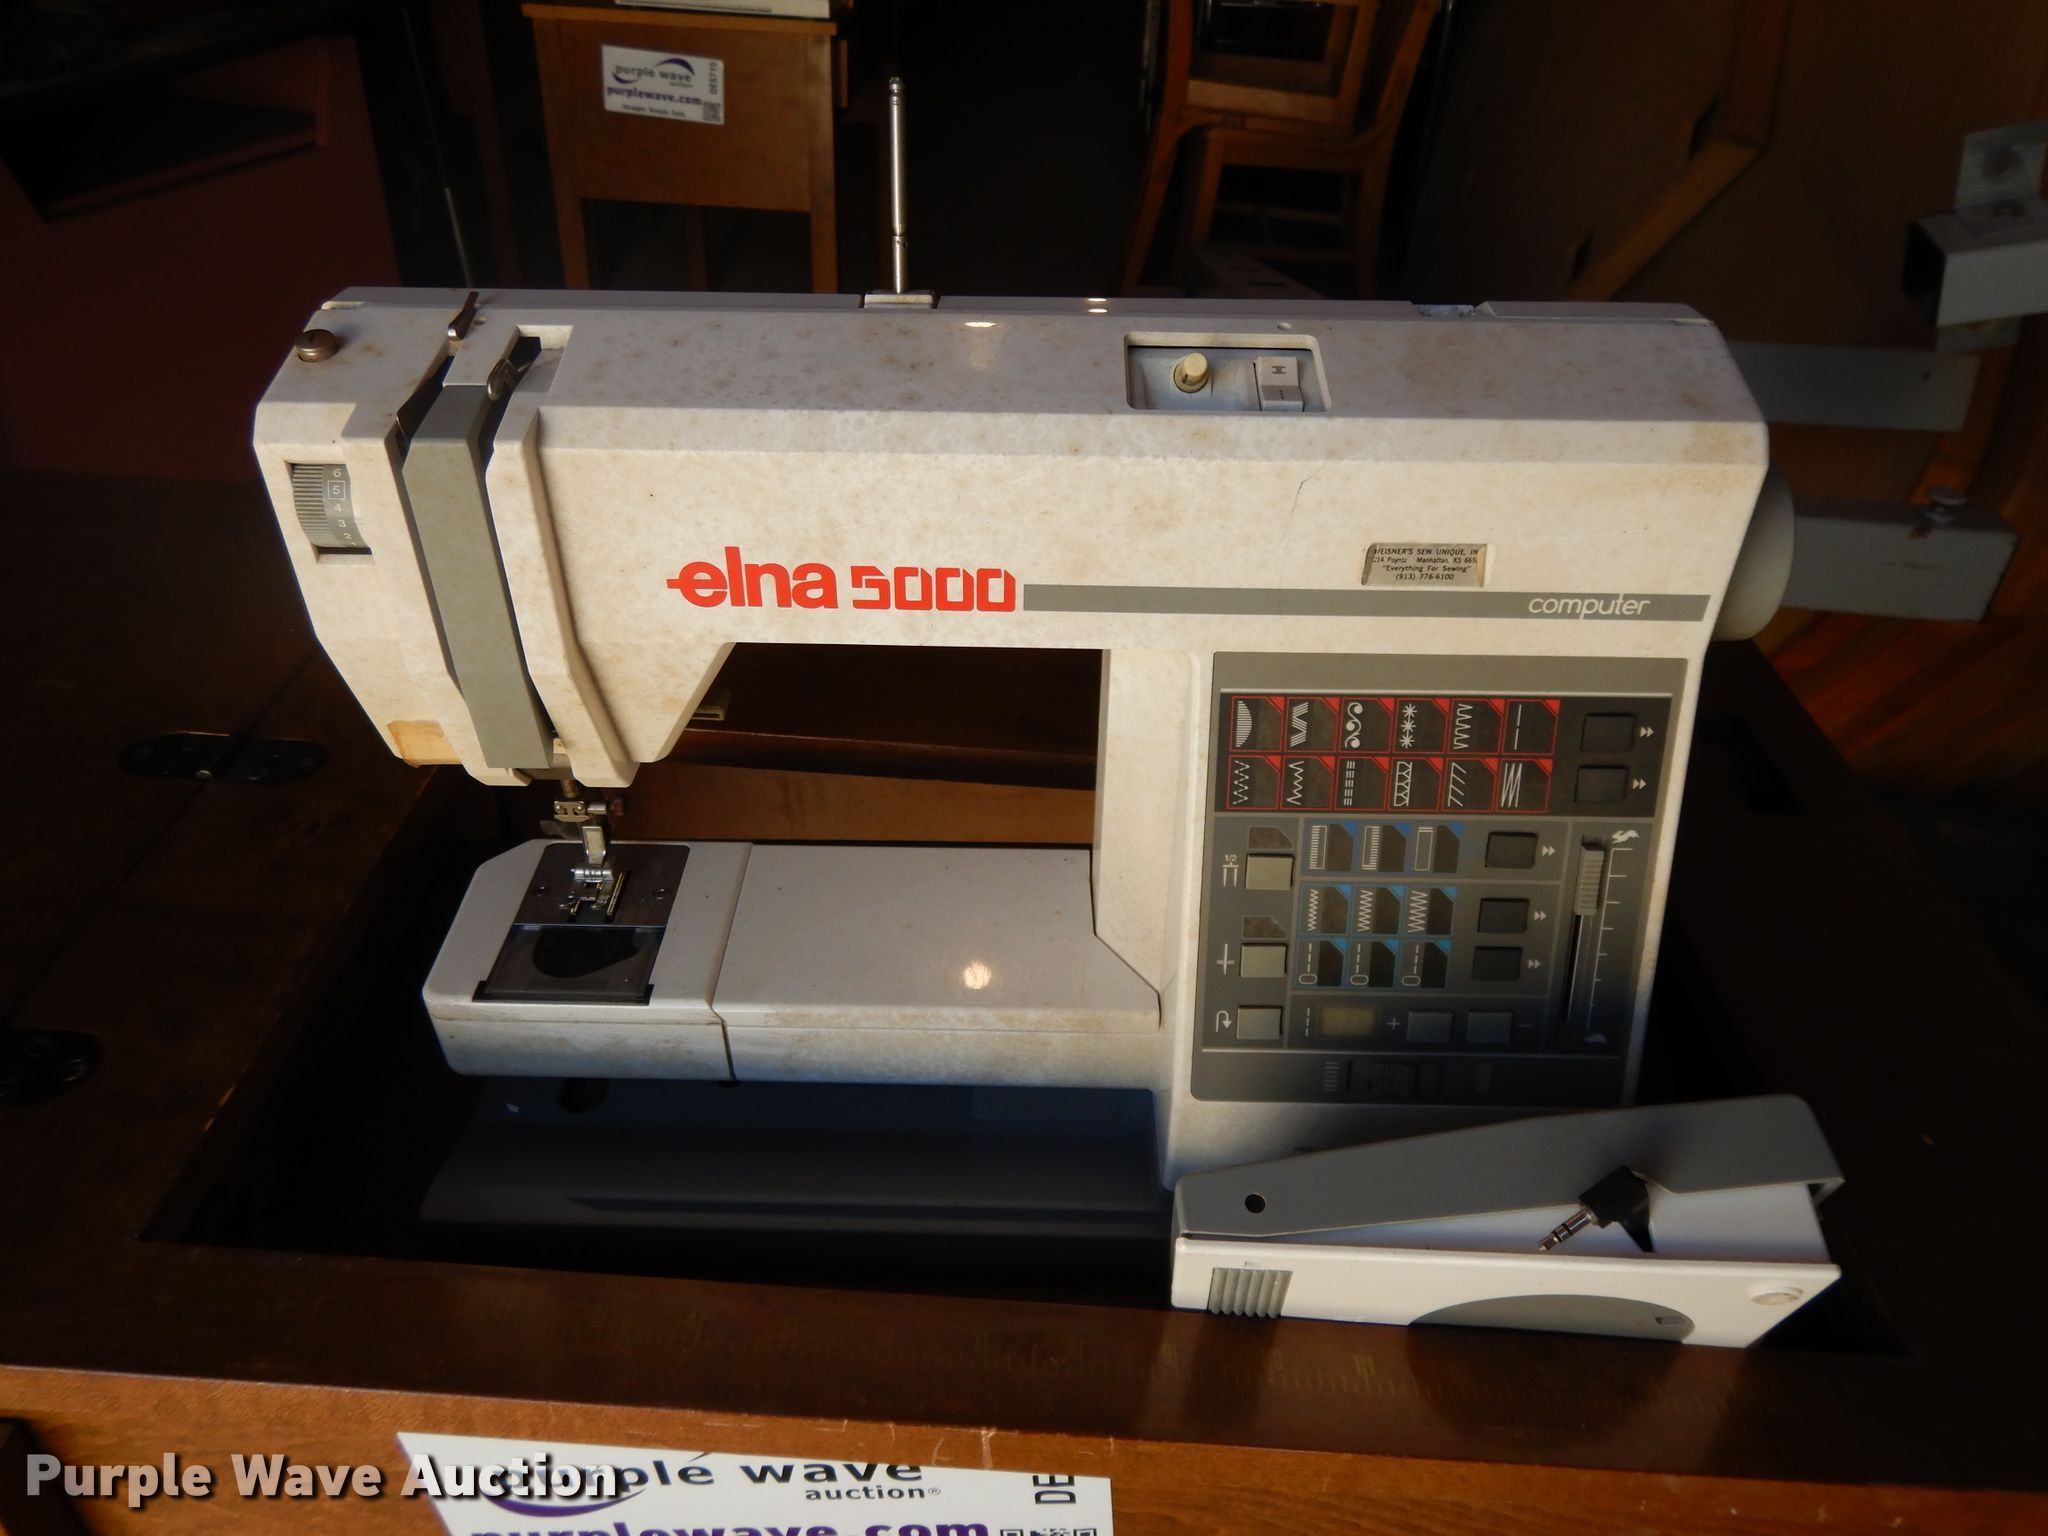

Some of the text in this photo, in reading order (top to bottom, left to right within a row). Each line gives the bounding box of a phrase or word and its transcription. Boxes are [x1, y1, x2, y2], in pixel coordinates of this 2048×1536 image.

[615, 65, 692, 82] purple wave
[607, 86, 702, 106] purplewave.com
[333, 468, 342, 478] 6
[332, 485, 341, 495] 5
[338, 519, 347, 528] 3
[1416, 548, 1432, 556] SEW
[666, 546, 1017, 613] elna 5000
[1395, 573, 1416, 581] (913)
[1528, 592, 1650, 620] computer
[740, 1462, 923, 1484] wave
[470, 1521, 989, 1536] lewavecom
